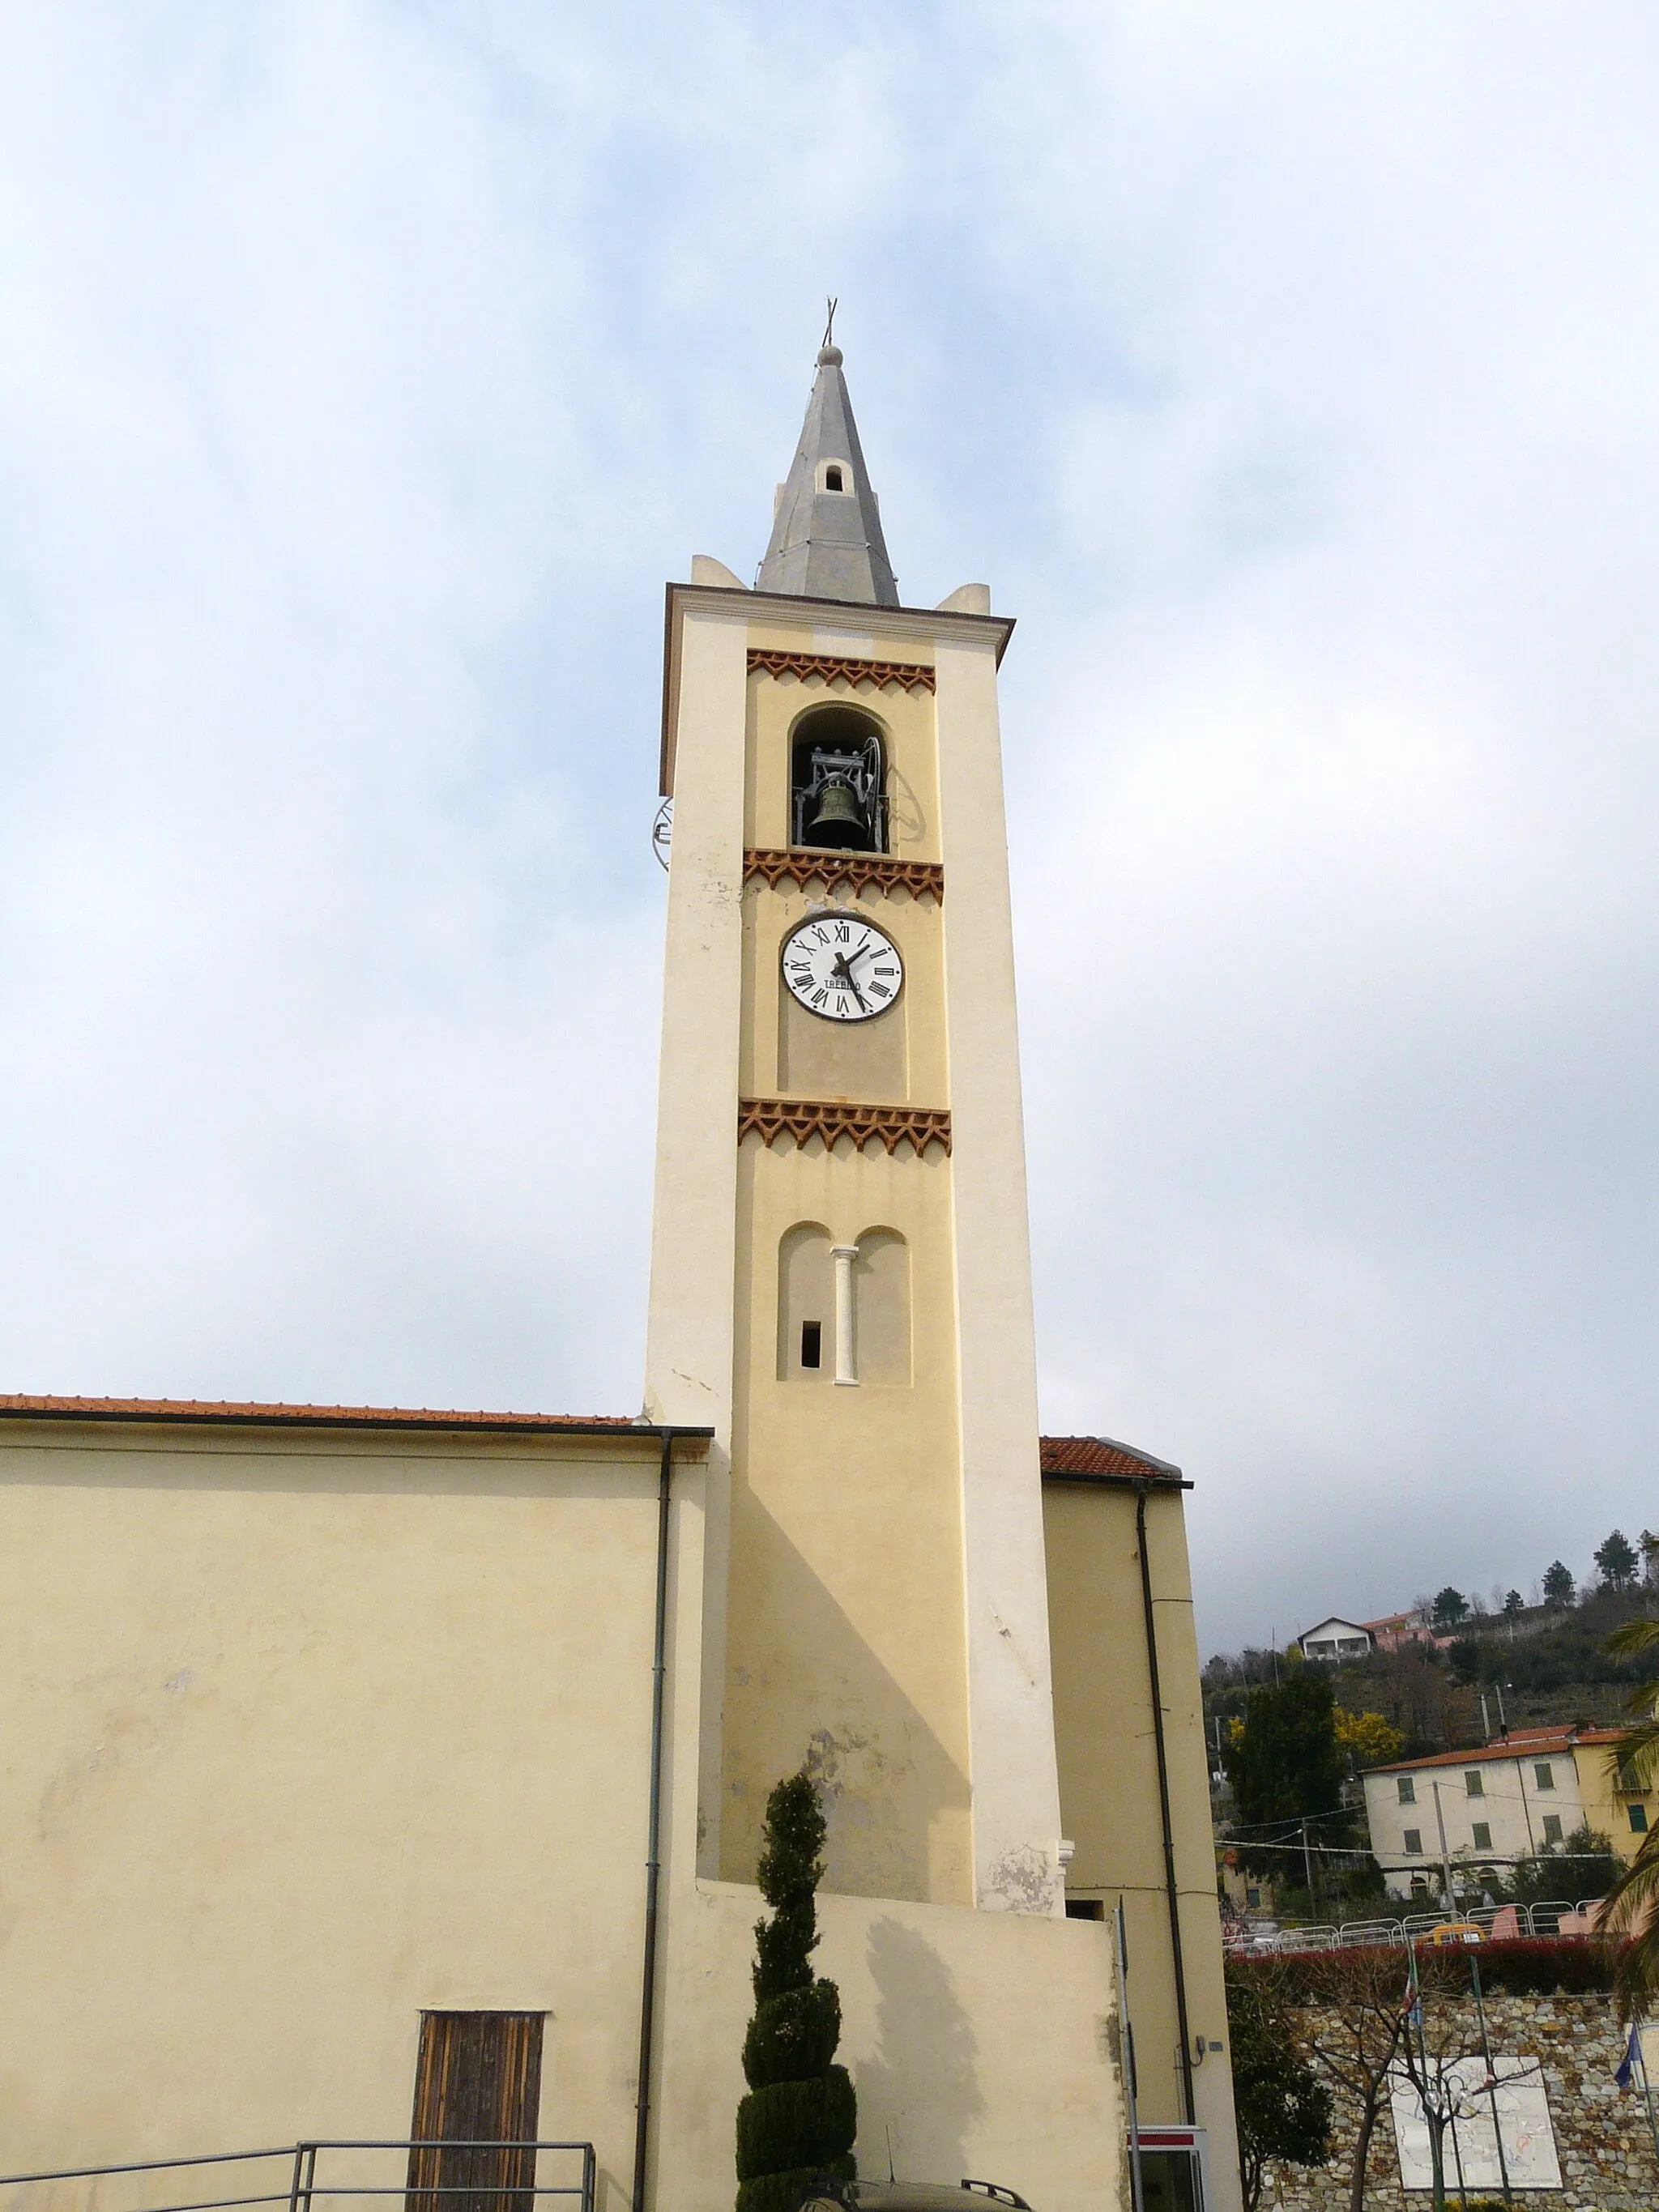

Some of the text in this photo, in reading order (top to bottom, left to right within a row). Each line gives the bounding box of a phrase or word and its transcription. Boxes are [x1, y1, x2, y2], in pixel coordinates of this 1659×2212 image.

[811, 927, 830, 946] XI
[834, 925, 849, 942] XII
[857, 933, 868, 947] I
[795, 940, 817, 956] X
[869, 948, 888, 959] II
[791, 960, 811, 971] IX
[874, 967, 894, 976] III
[794, 974, 817, 993] VIII
[868, 981, 890, 998] IIII
[810, 987, 829, 1008] VII
[836, 995, 850, 1013] VI
